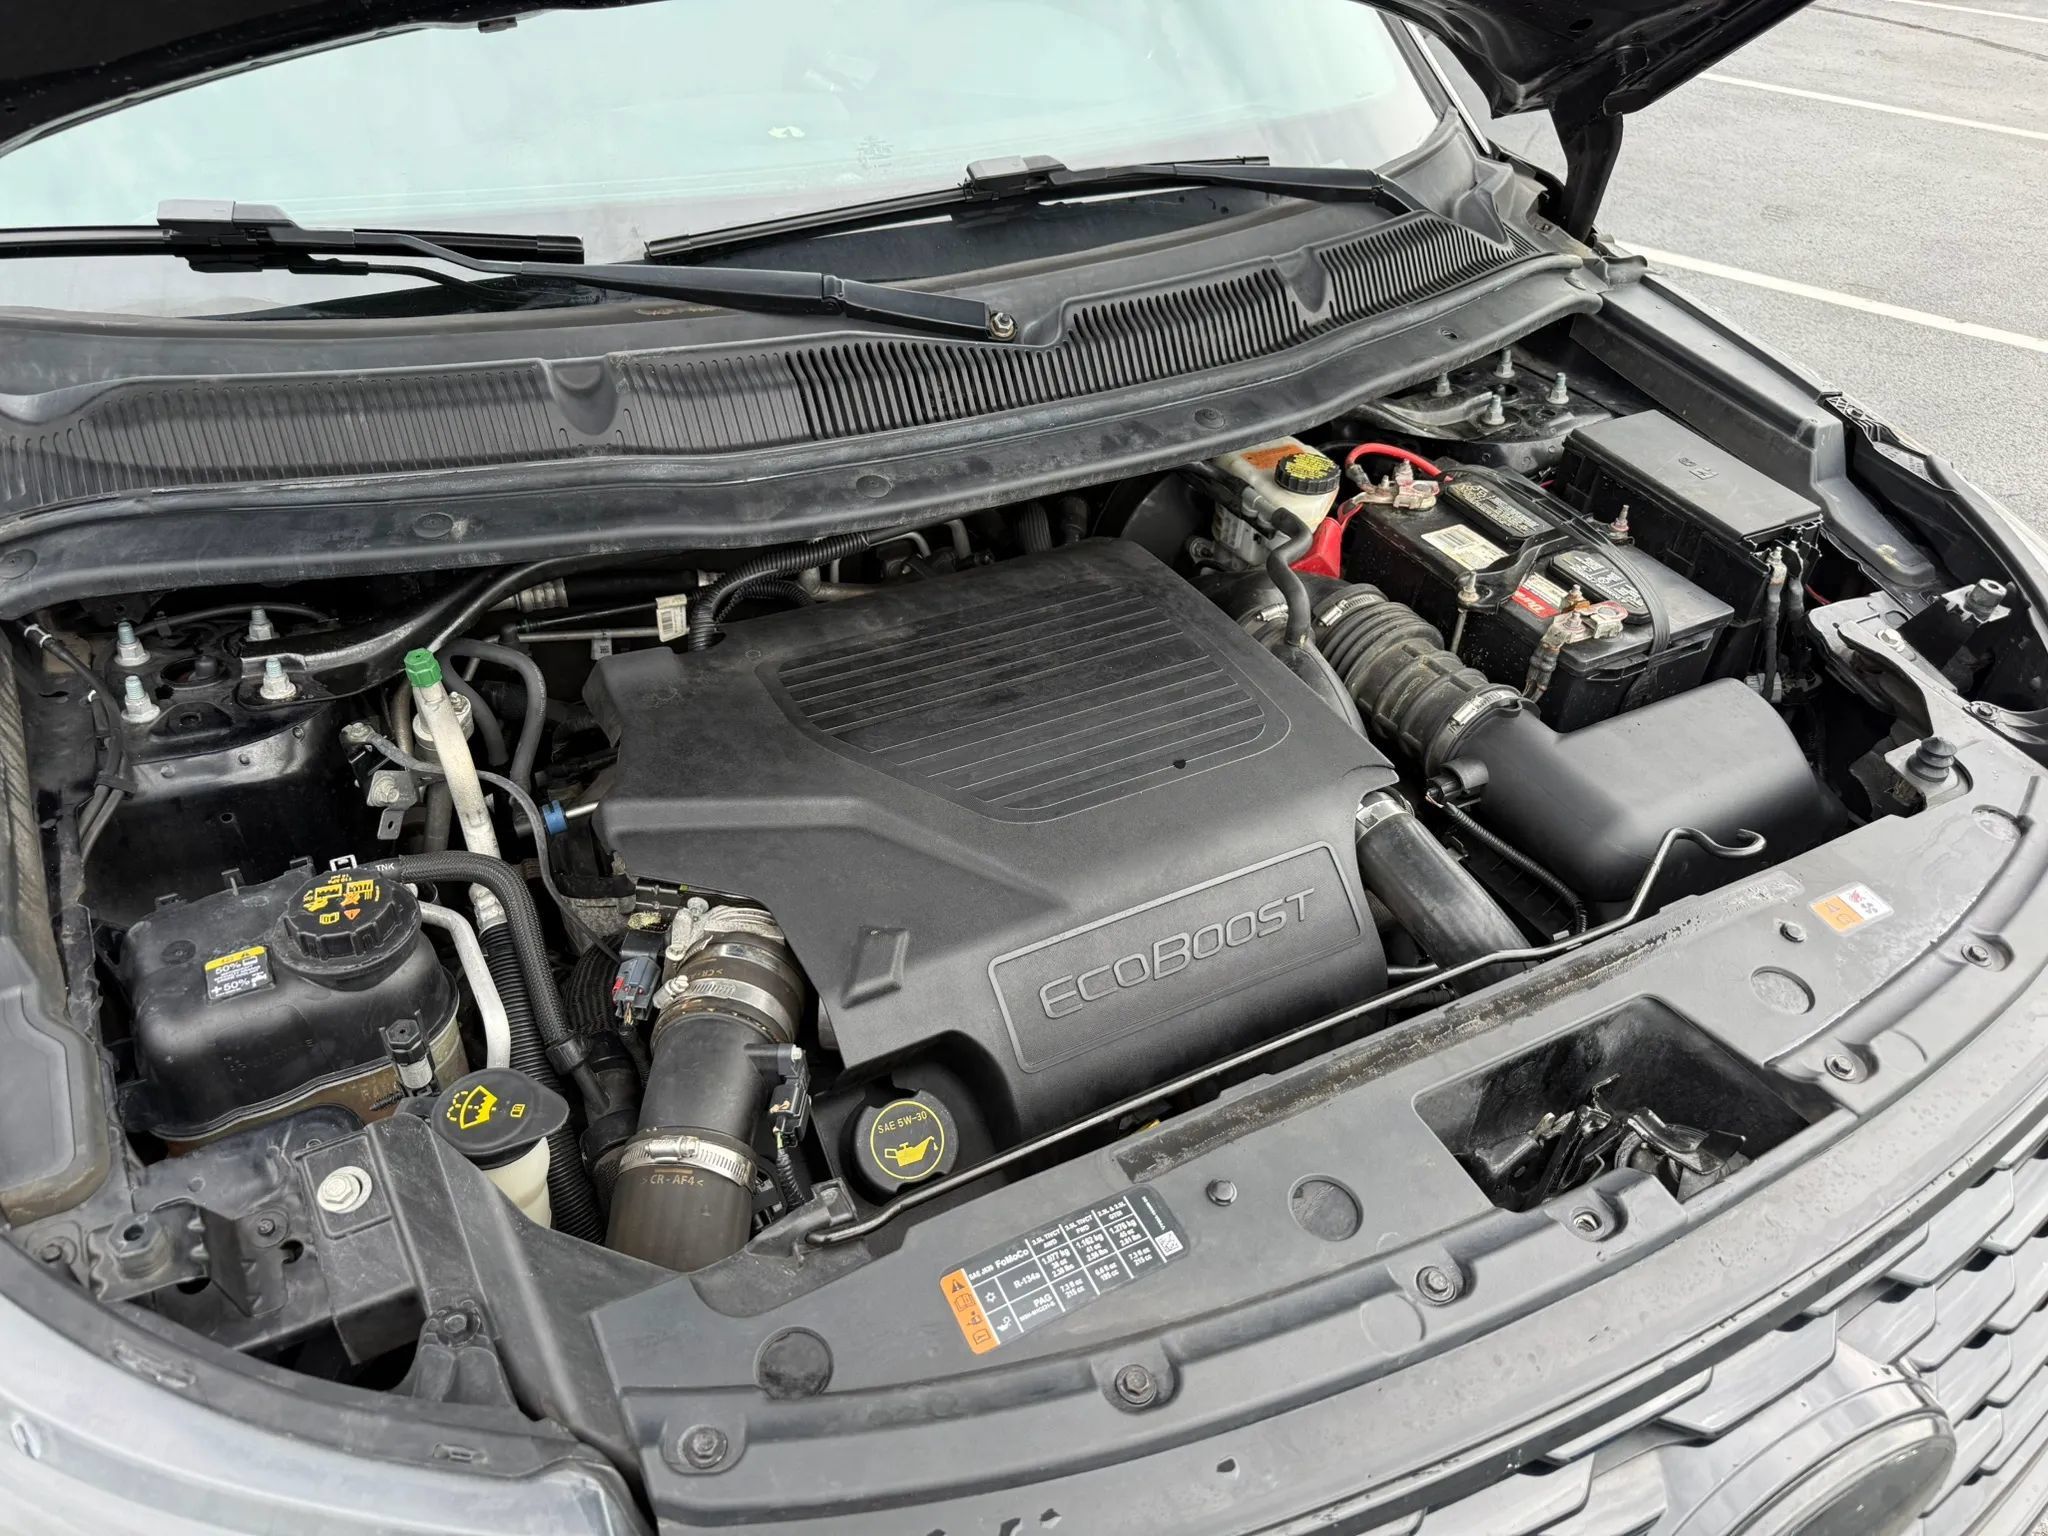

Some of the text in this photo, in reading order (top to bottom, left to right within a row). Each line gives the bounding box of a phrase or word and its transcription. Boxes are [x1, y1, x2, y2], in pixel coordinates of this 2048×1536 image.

[374, 862, 395, 872] TNK
[877, 1110, 928, 1134] SAE 5W-30
[1126, 1219, 1137, 1227] kg
[1093, 1233, 1104, 1241] kg
[995, 1249, 1029, 1268] FoMoCo
[1042, 1249, 1070, 1264] 1.077 kg
[1014, 1273, 1040, 1288] R-134a
[1033, 1294, 1052, 1307] PAG
